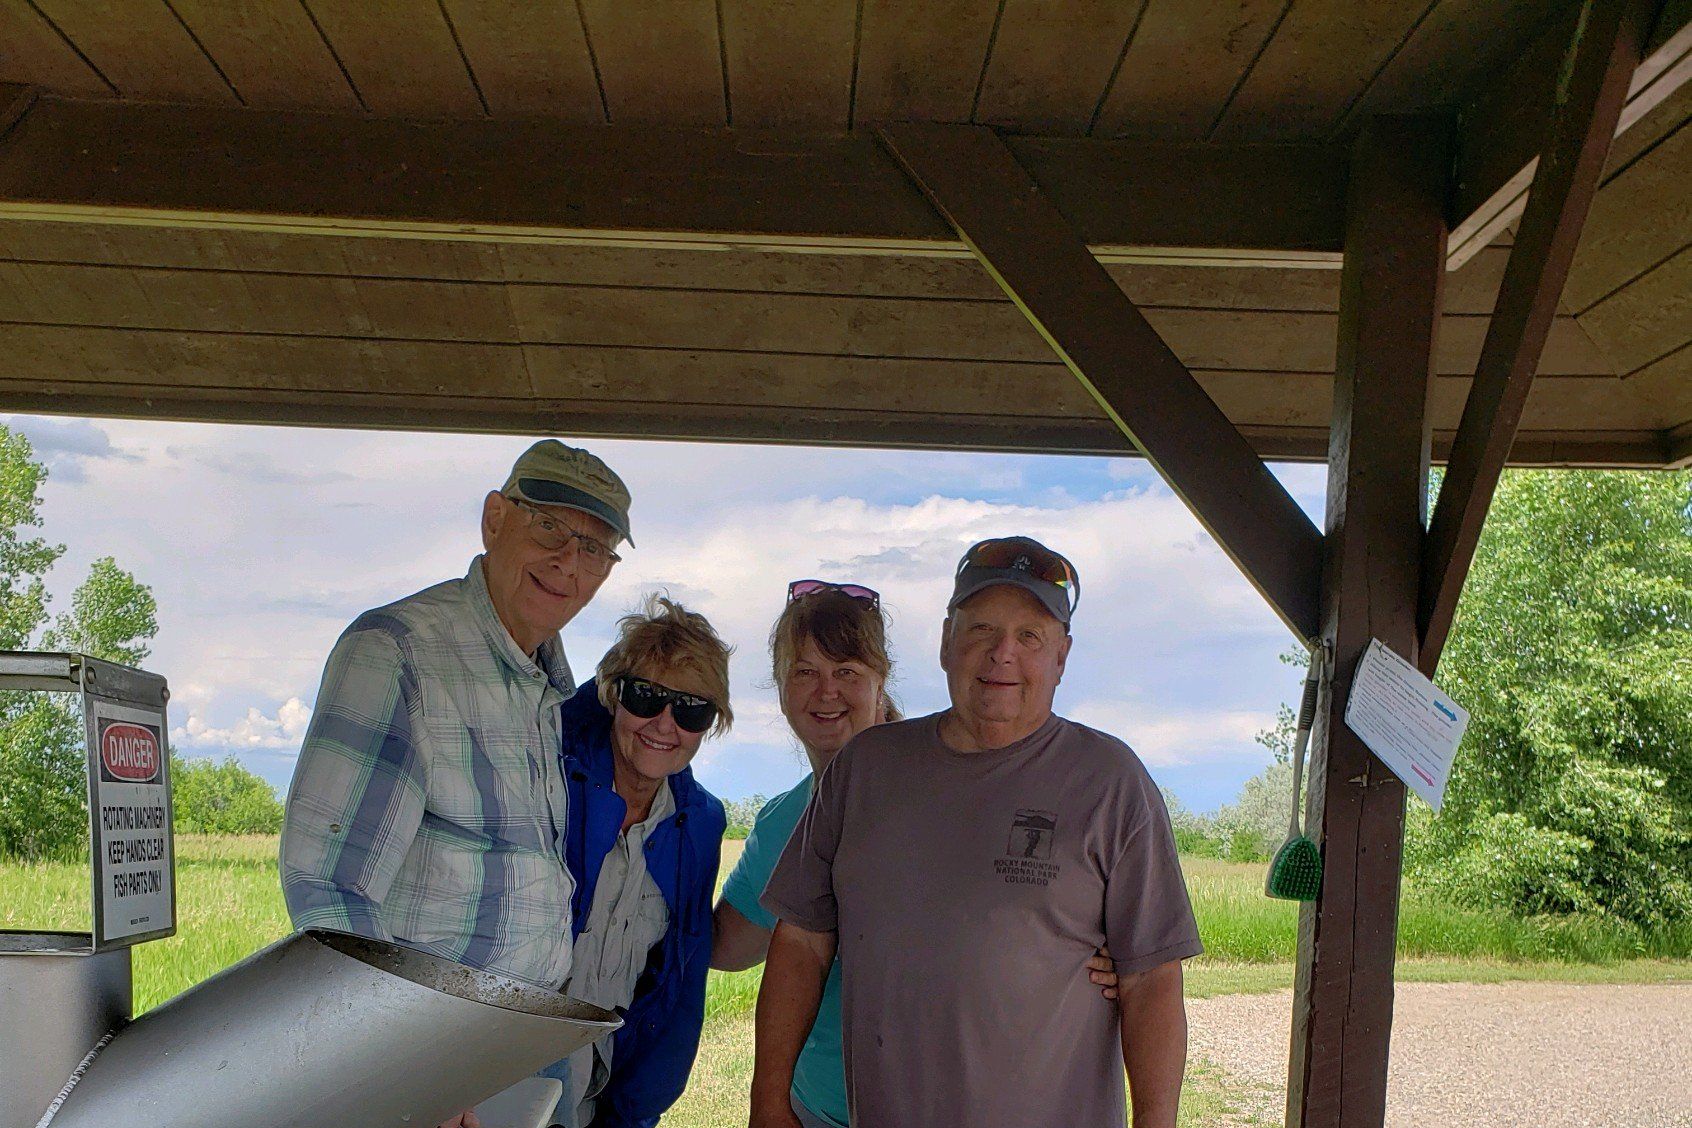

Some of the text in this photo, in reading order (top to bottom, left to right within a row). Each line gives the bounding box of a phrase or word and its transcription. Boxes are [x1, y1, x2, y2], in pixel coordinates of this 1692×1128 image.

[109, 735, 154, 769] DANGER
[102, 806, 166, 831] ROTATING MACHINERY
[108, 838, 165, 865] KEEP HANDS CLEAR
[993, 859, 1060, 872] ROCKY MOUNTAIN
[995, 867, 1057, 880] NATIONAL PARK
[113, 870, 162, 898] FISH PARTS ONLY
[1004, 875, 1049, 886] COLORADO
